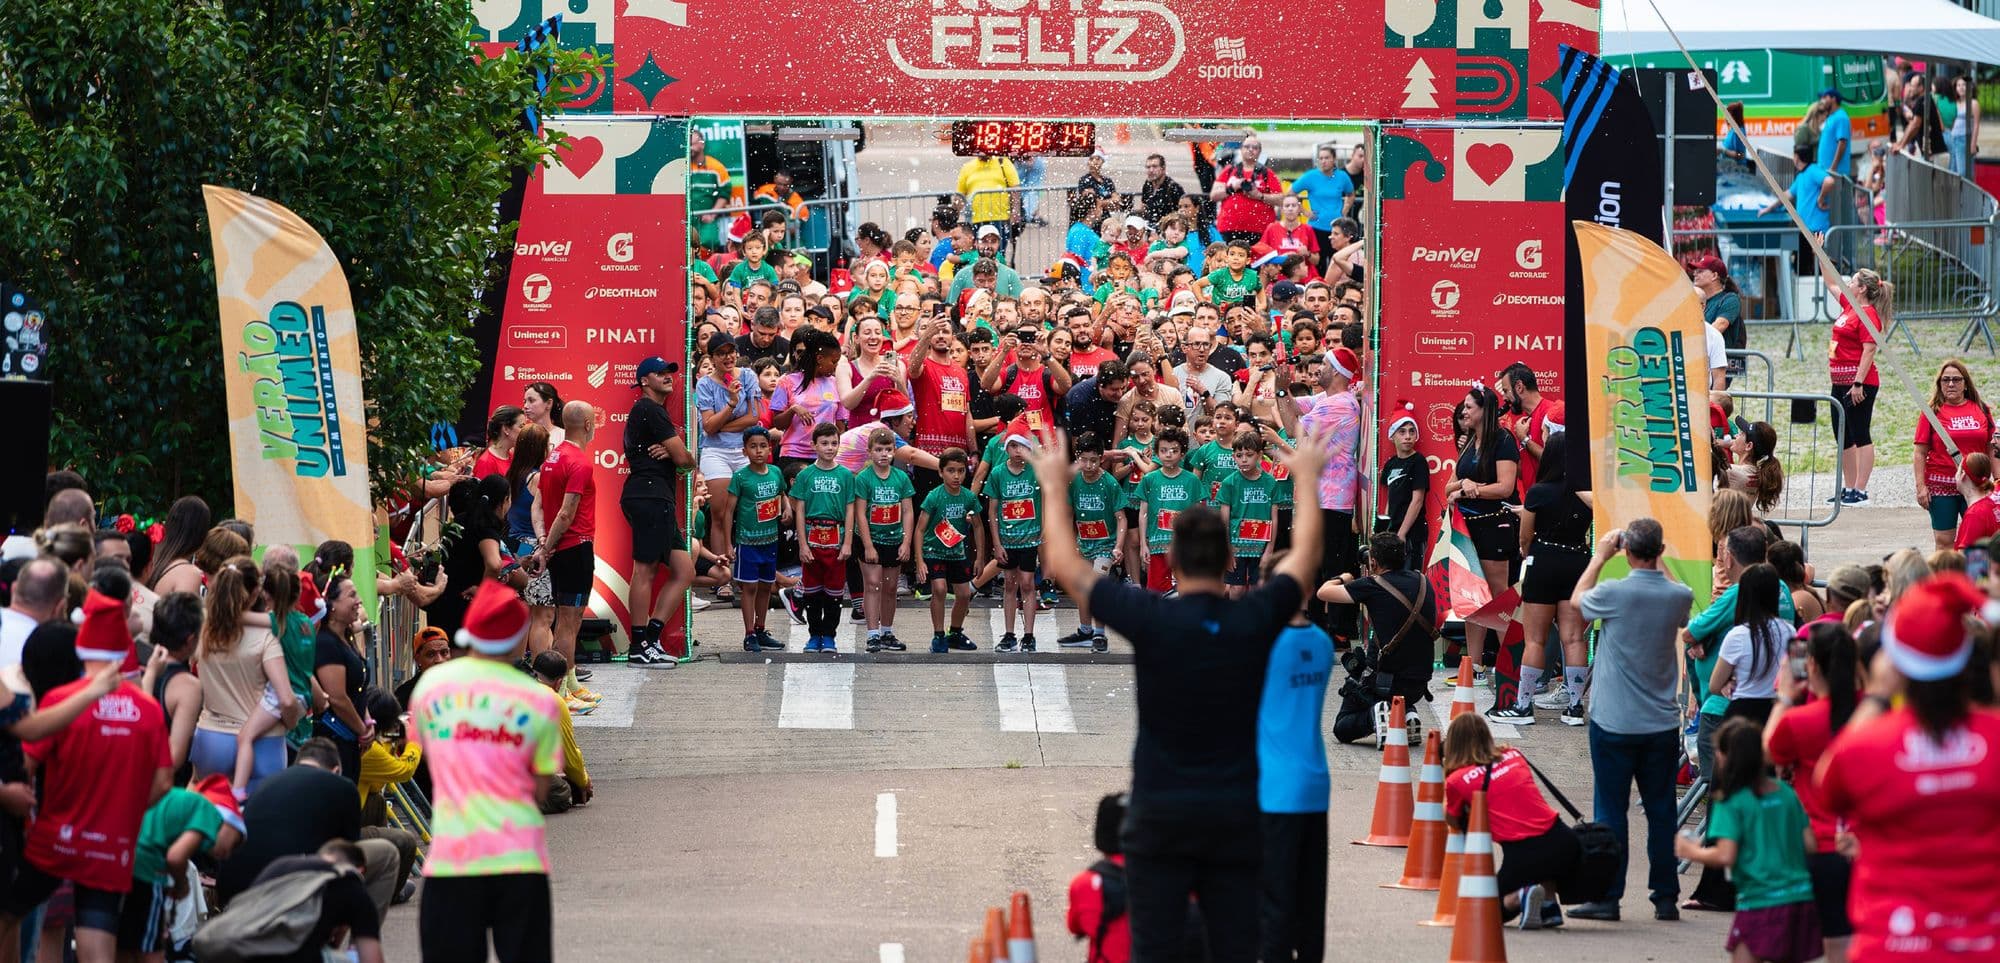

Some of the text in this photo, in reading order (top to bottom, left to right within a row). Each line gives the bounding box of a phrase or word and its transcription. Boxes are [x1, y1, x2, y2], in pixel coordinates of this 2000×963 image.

[930, 16, 1140, 65] FELIZ
[1198, 62, 1262, 80] sportion
[514, 240, 572, 256] anVel
[1411, 246, 1481, 263] PanVel
[600, 264, 639, 272] GATORADE
[599, 288, 657, 298] DECATHLON
[1507, 294, 1565, 305] DECATHLON
[514, 330, 550, 339] Unimed
[586, 327, 655, 344] PINATI
[1421, 336, 1457, 346] Unimed
[1493, 334, 1563, 351] PINATI
[517, 371, 573, 381] Risotolândia
[1424, 378, 1474, 387] Risotolândi
[238, 320, 299, 460] VERÃO
[269, 301, 331, 479] UNIMED
[318, 331, 341, 451] EM MOVIMENTO
[1602, 345, 1654, 478] VERÃO
[1633, 326, 1683, 493] UNIMED
[1674, 355, 1693, 467] EM MOVIMENTO
